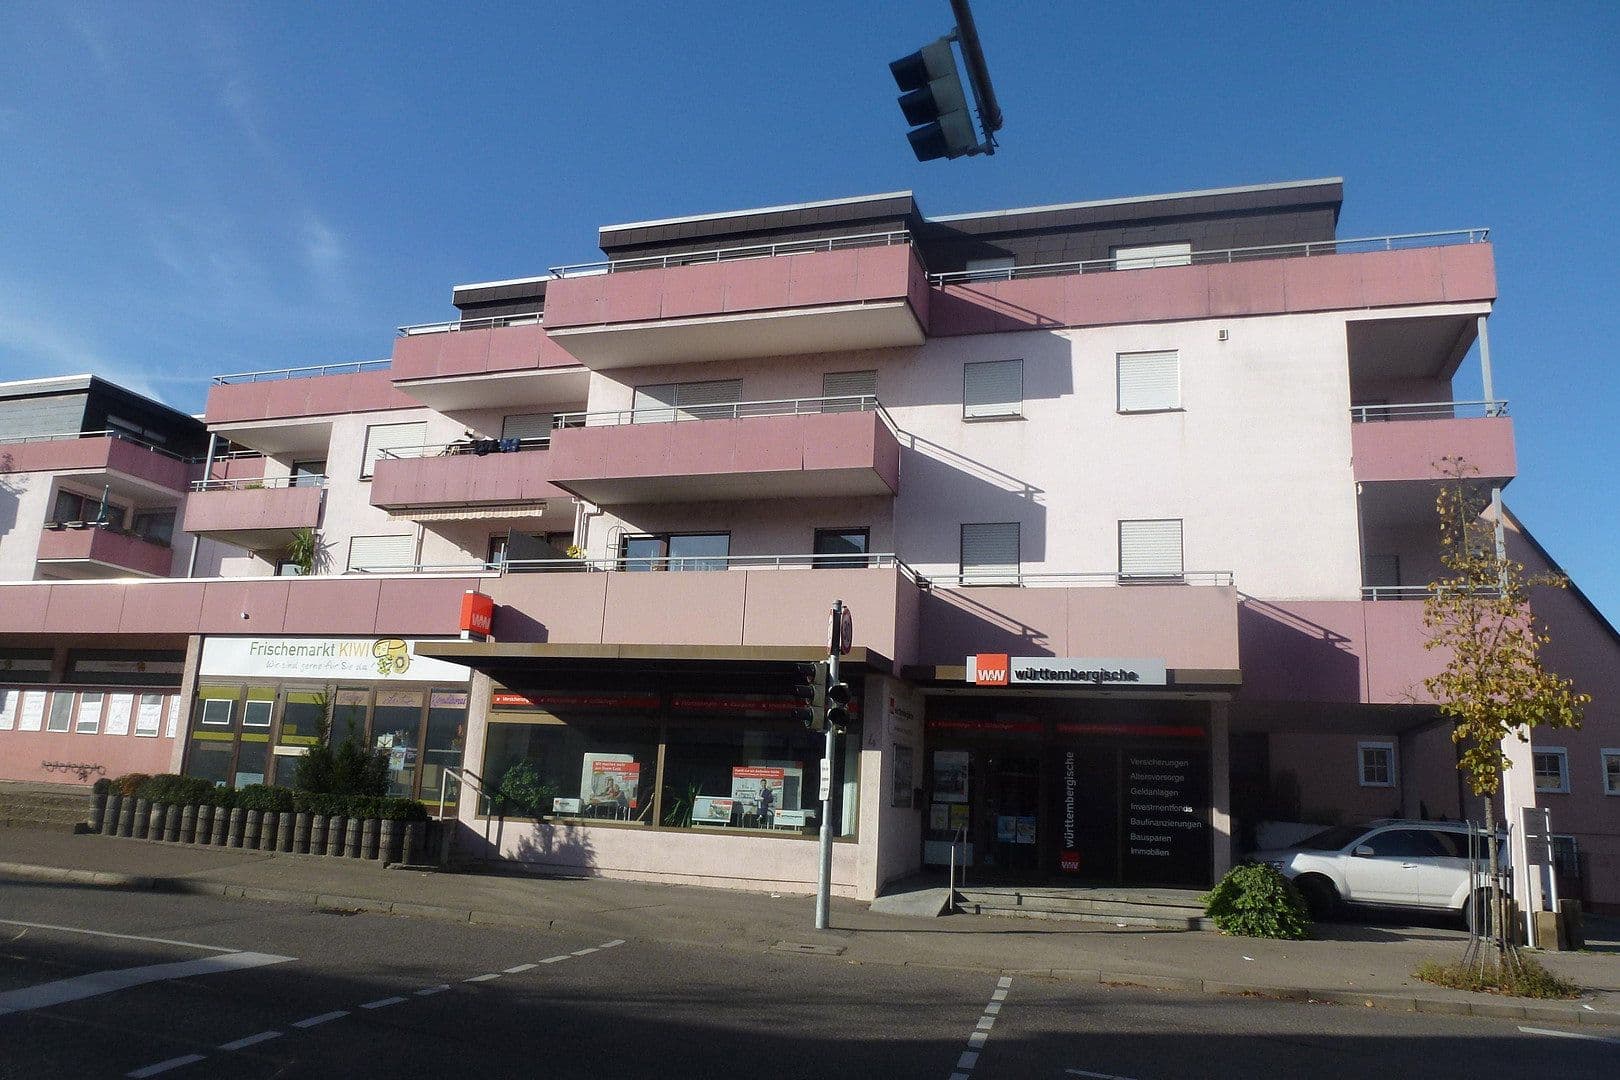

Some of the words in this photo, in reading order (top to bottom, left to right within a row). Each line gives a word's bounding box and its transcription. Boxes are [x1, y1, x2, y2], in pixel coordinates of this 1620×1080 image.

[249, 642, 335, 657] Frischemarkt
[339, 642, 370, 657] KIWI
[1015, 667, 1139, 685] württembergische
[1130, 758, 1189, 768] Versicherungen
[1130, 773, 1185, 782] Altersvorsorge
[1130, 787, 1179, 797] Geldanlagen
[1064, 751, 1077, 849] württembergische
[1130, 803, 1193, 812] Investmentfonds
[1130, 818, 1202, 829] Baufinanzierungen
[1130, 833, 1172, 843] Bausparen
[1130, 847, 1170, 856] Immobilien
